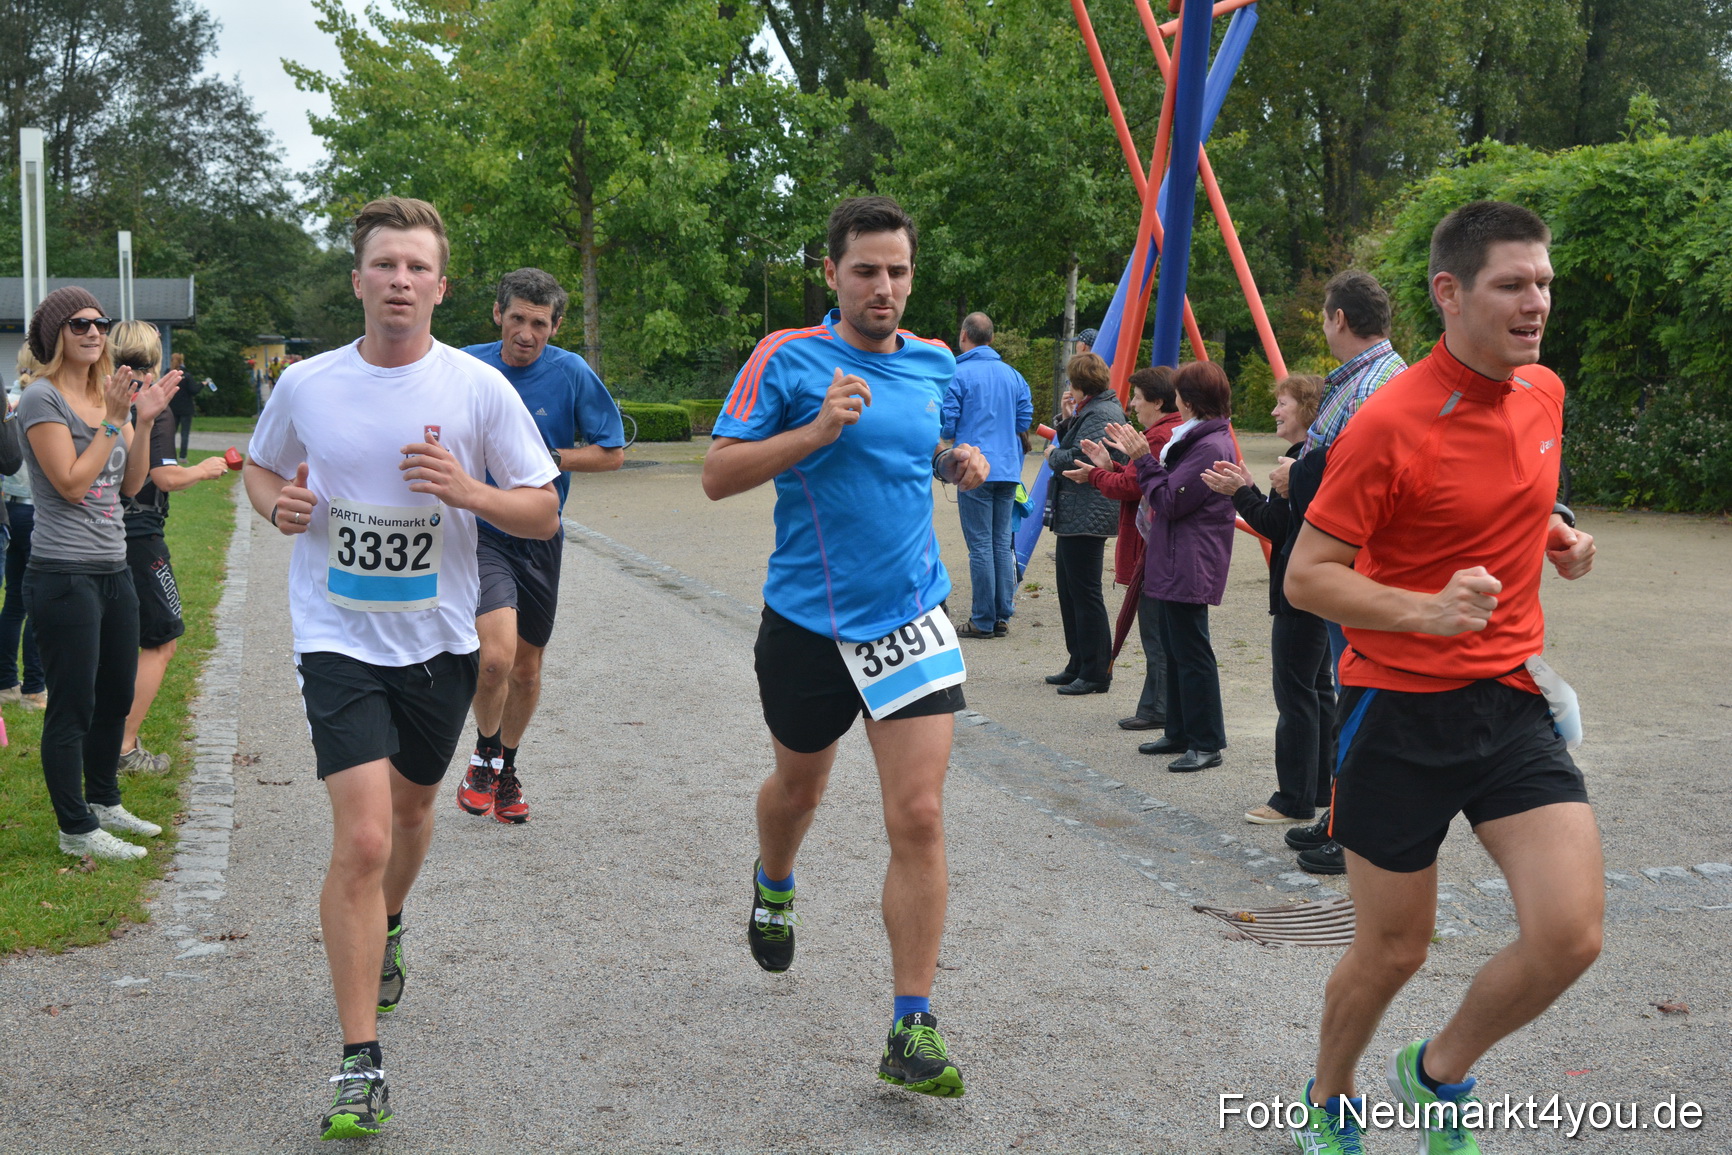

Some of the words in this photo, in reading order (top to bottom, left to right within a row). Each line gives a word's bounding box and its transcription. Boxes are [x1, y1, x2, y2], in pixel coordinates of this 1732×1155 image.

[330, 506, 365, 524] PARTL
[368, 515, 425, 528] Neumarkt
[337, 526, 433, 572] 3332
[854, 615, 946, 678] 3391
